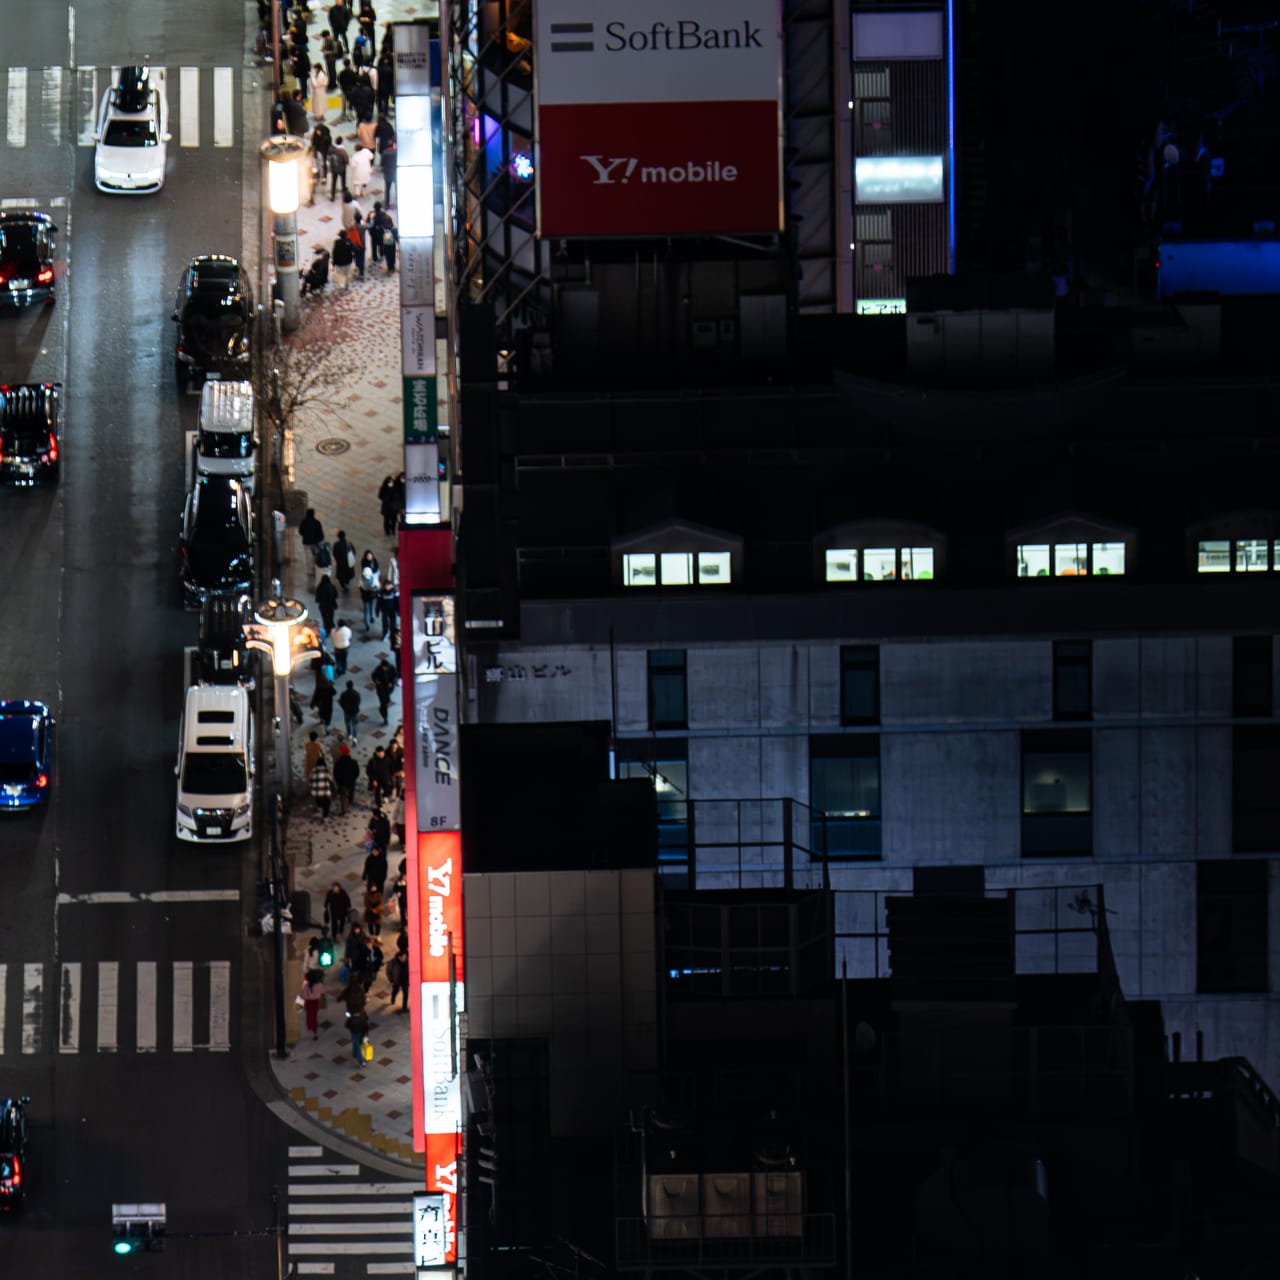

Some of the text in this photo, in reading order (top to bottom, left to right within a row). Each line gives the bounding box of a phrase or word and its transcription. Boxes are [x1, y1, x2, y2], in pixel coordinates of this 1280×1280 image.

[605, 21, 763, 53] SoftBank
[434, 707, 451, 786] DANCE
[430, 816, 447, 828] 8F
